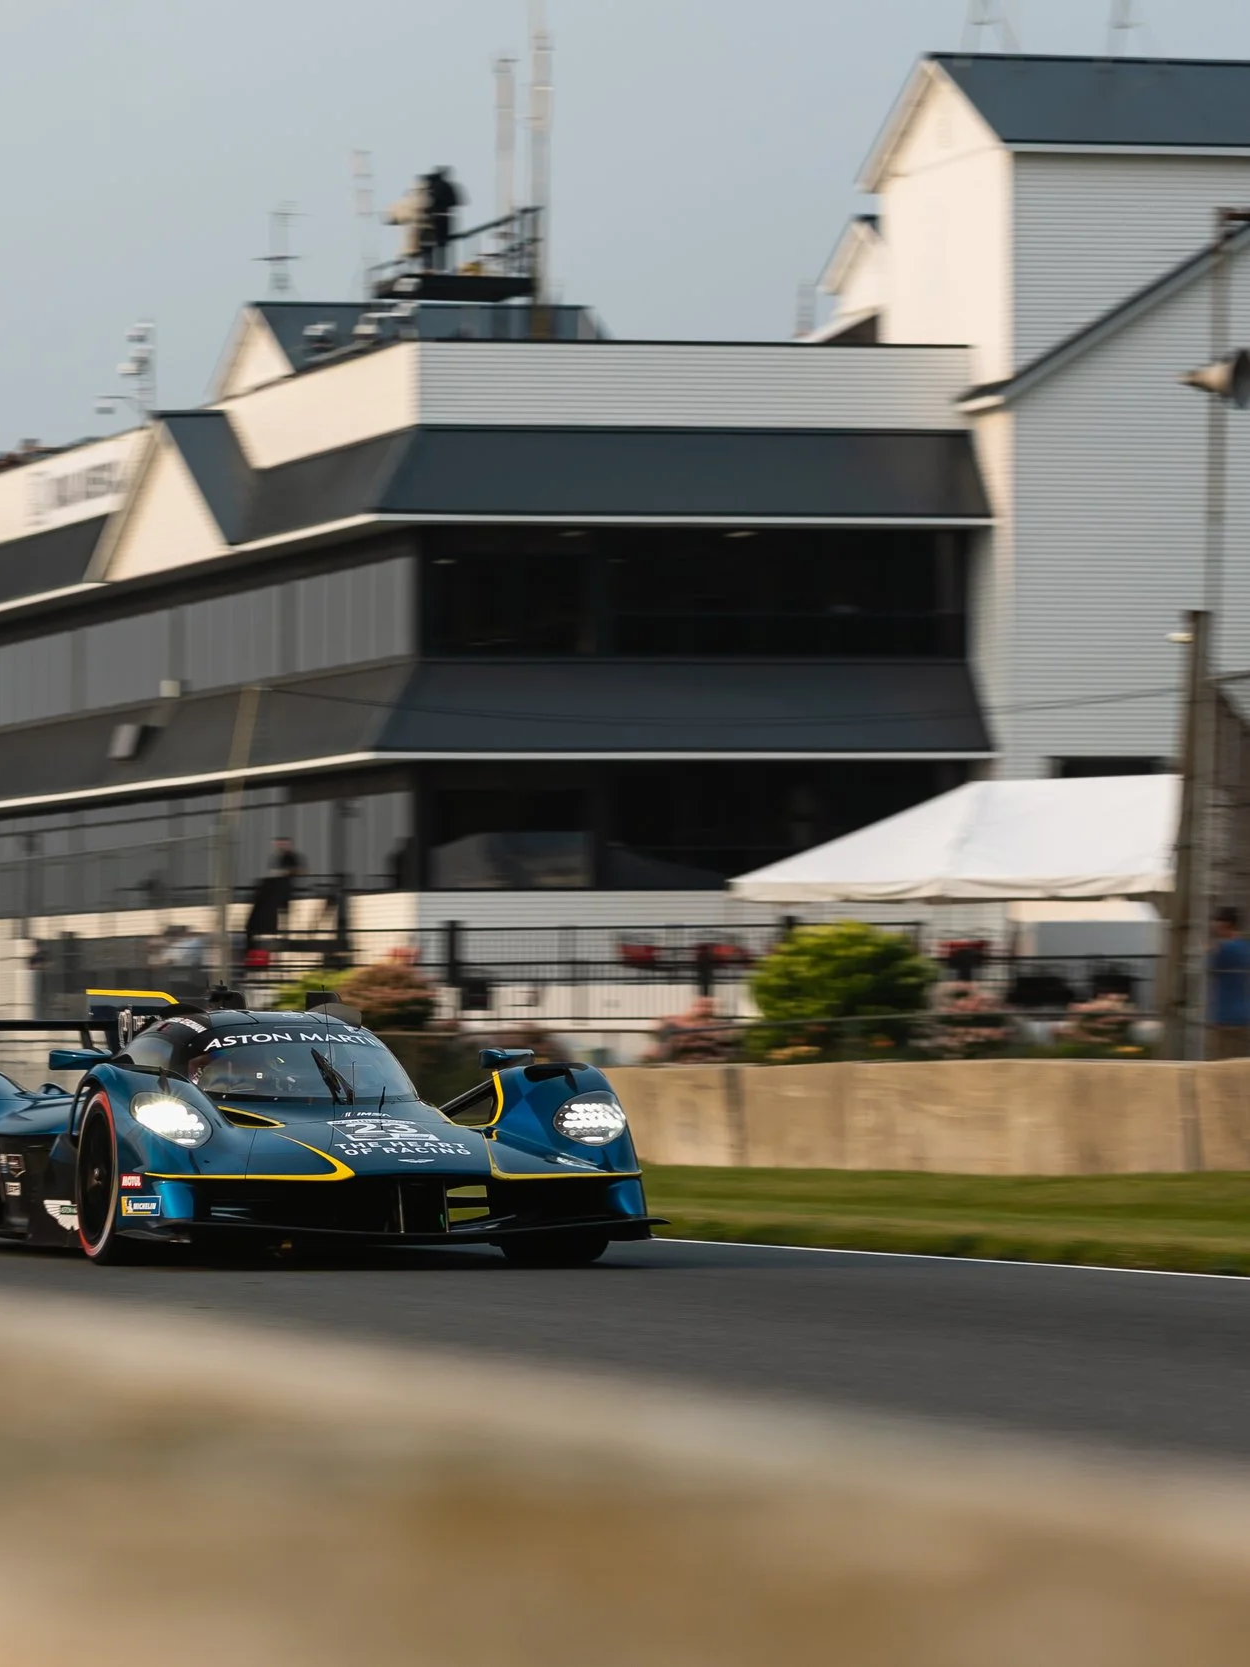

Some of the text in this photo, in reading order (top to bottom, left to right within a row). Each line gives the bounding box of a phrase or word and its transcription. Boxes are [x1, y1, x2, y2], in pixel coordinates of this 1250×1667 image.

[203, 1033, 292, 1051] ASTON
[346, 1123, 418, 1134] 23
[334, 1141, 466, 1149] THE HEART
[345, 1148, 472, 1156] OF RACING
